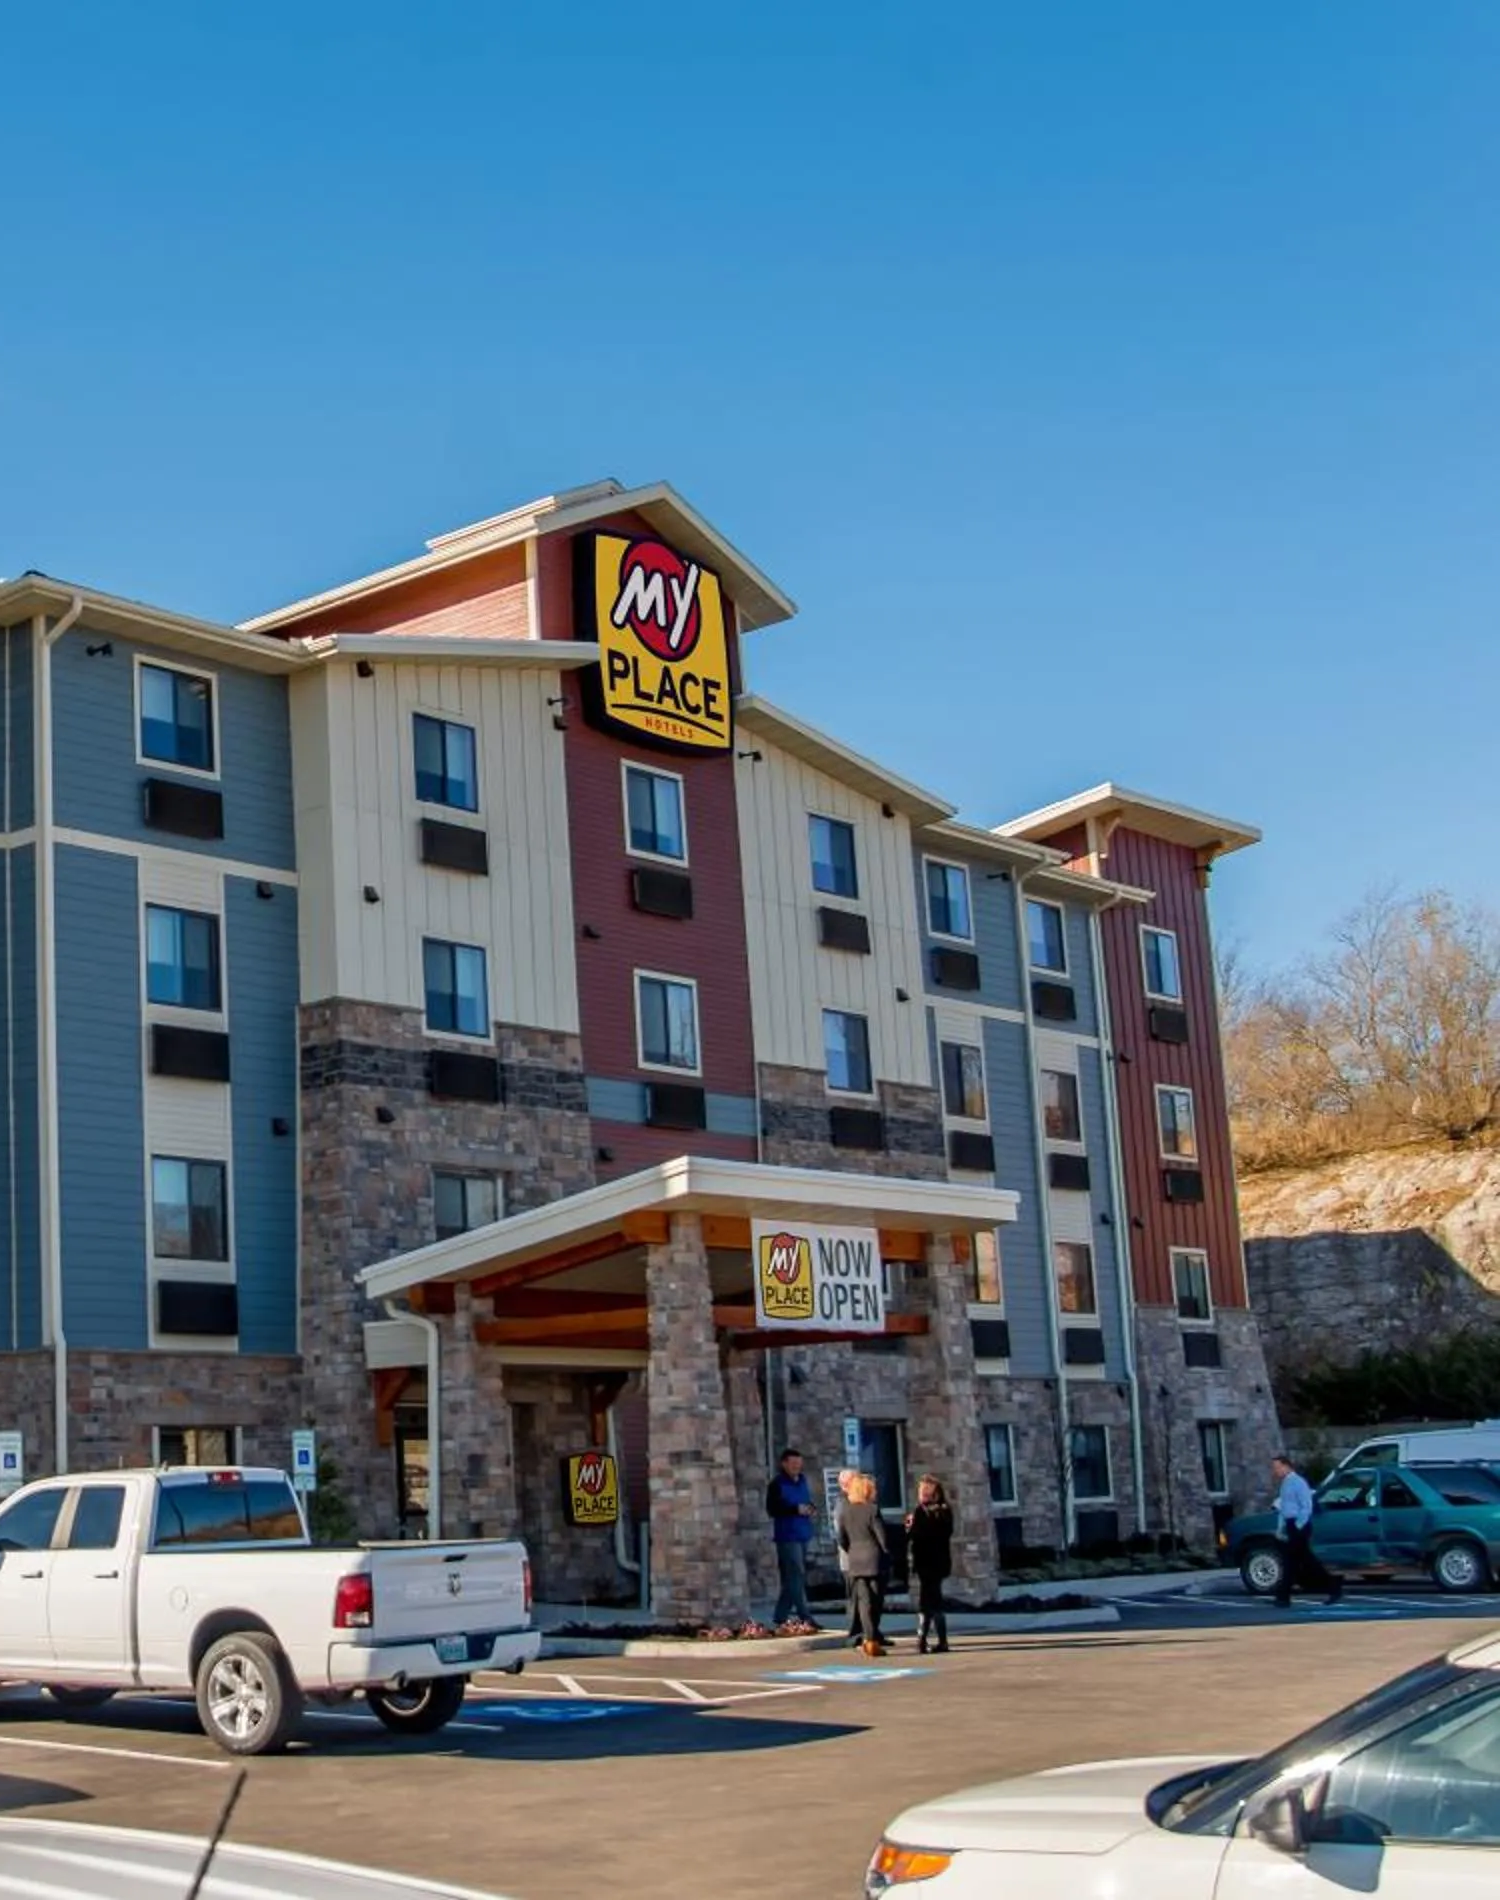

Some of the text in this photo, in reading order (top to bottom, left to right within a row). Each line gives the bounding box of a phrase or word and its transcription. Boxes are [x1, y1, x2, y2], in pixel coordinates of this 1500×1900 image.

[607, 648, 725, 723] PLACE
[644, 715, 693, 739] HOTELS
[818, 1237, 871, 1278] NOW
[766, 1286, 809, 1305] PLACE
[819, 1281, 879, 1322] OPEN
[575, 1496, 615, 1512] PLACE
